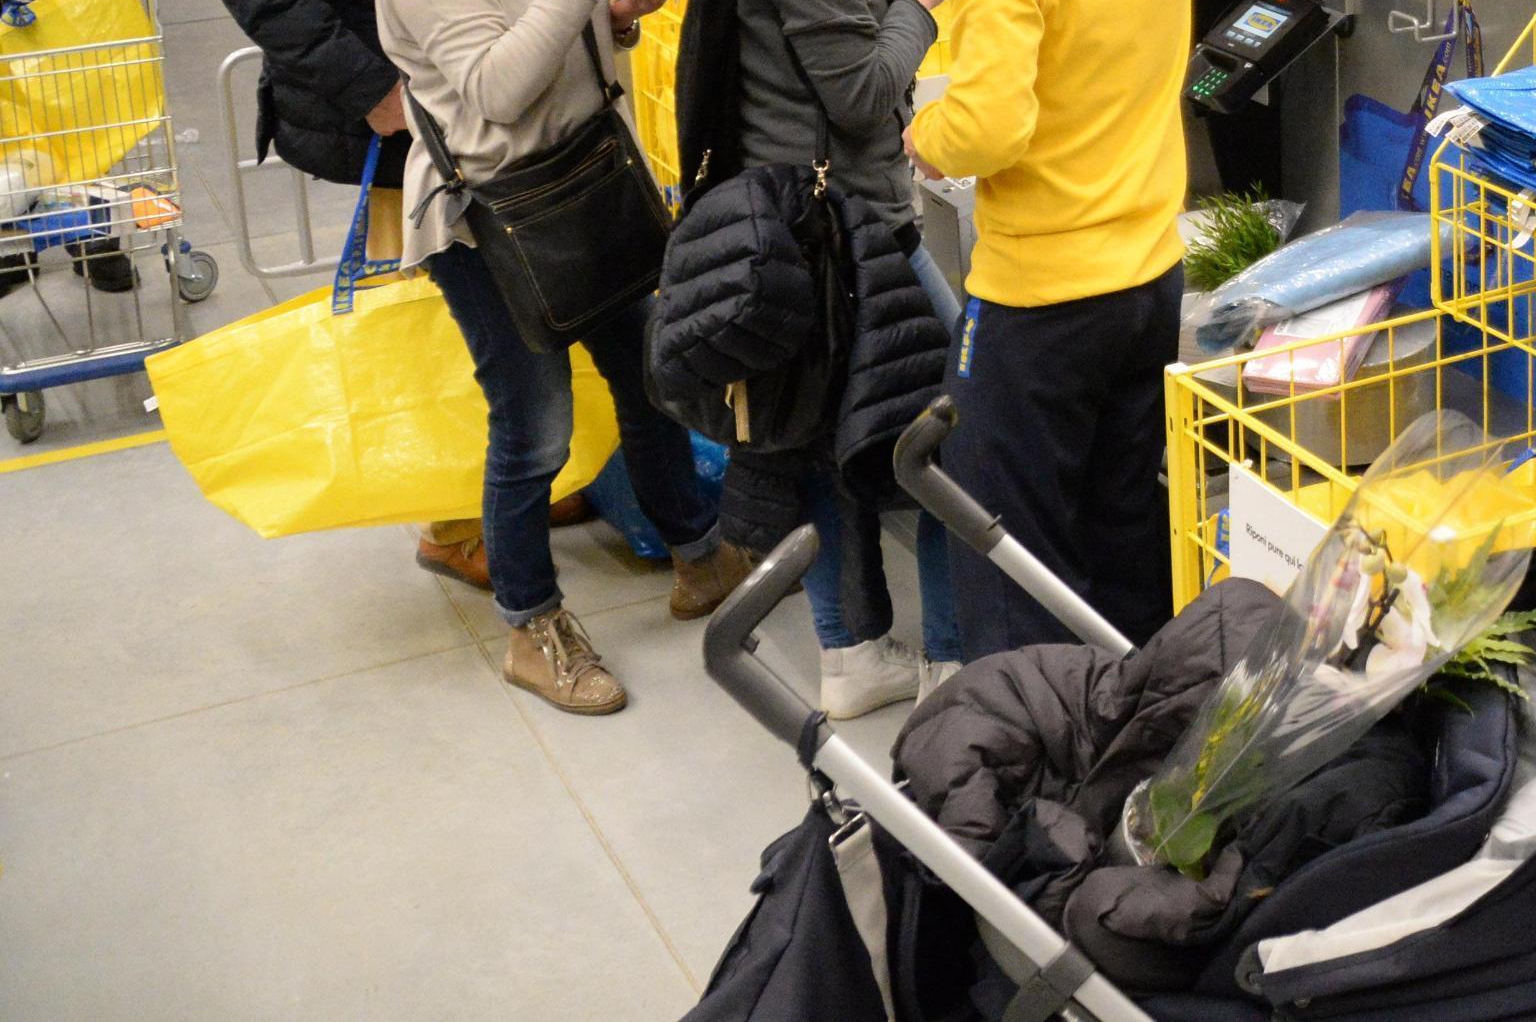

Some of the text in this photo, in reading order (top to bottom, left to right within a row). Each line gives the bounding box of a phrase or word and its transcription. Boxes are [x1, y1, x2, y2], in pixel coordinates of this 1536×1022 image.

[1424, 63, 1446, 121] IKEA
[1246, 523, 1268, 547] Riponi
[1267, 541, 1285, 559] pure
[1284, 553, 1297, 568] qui
